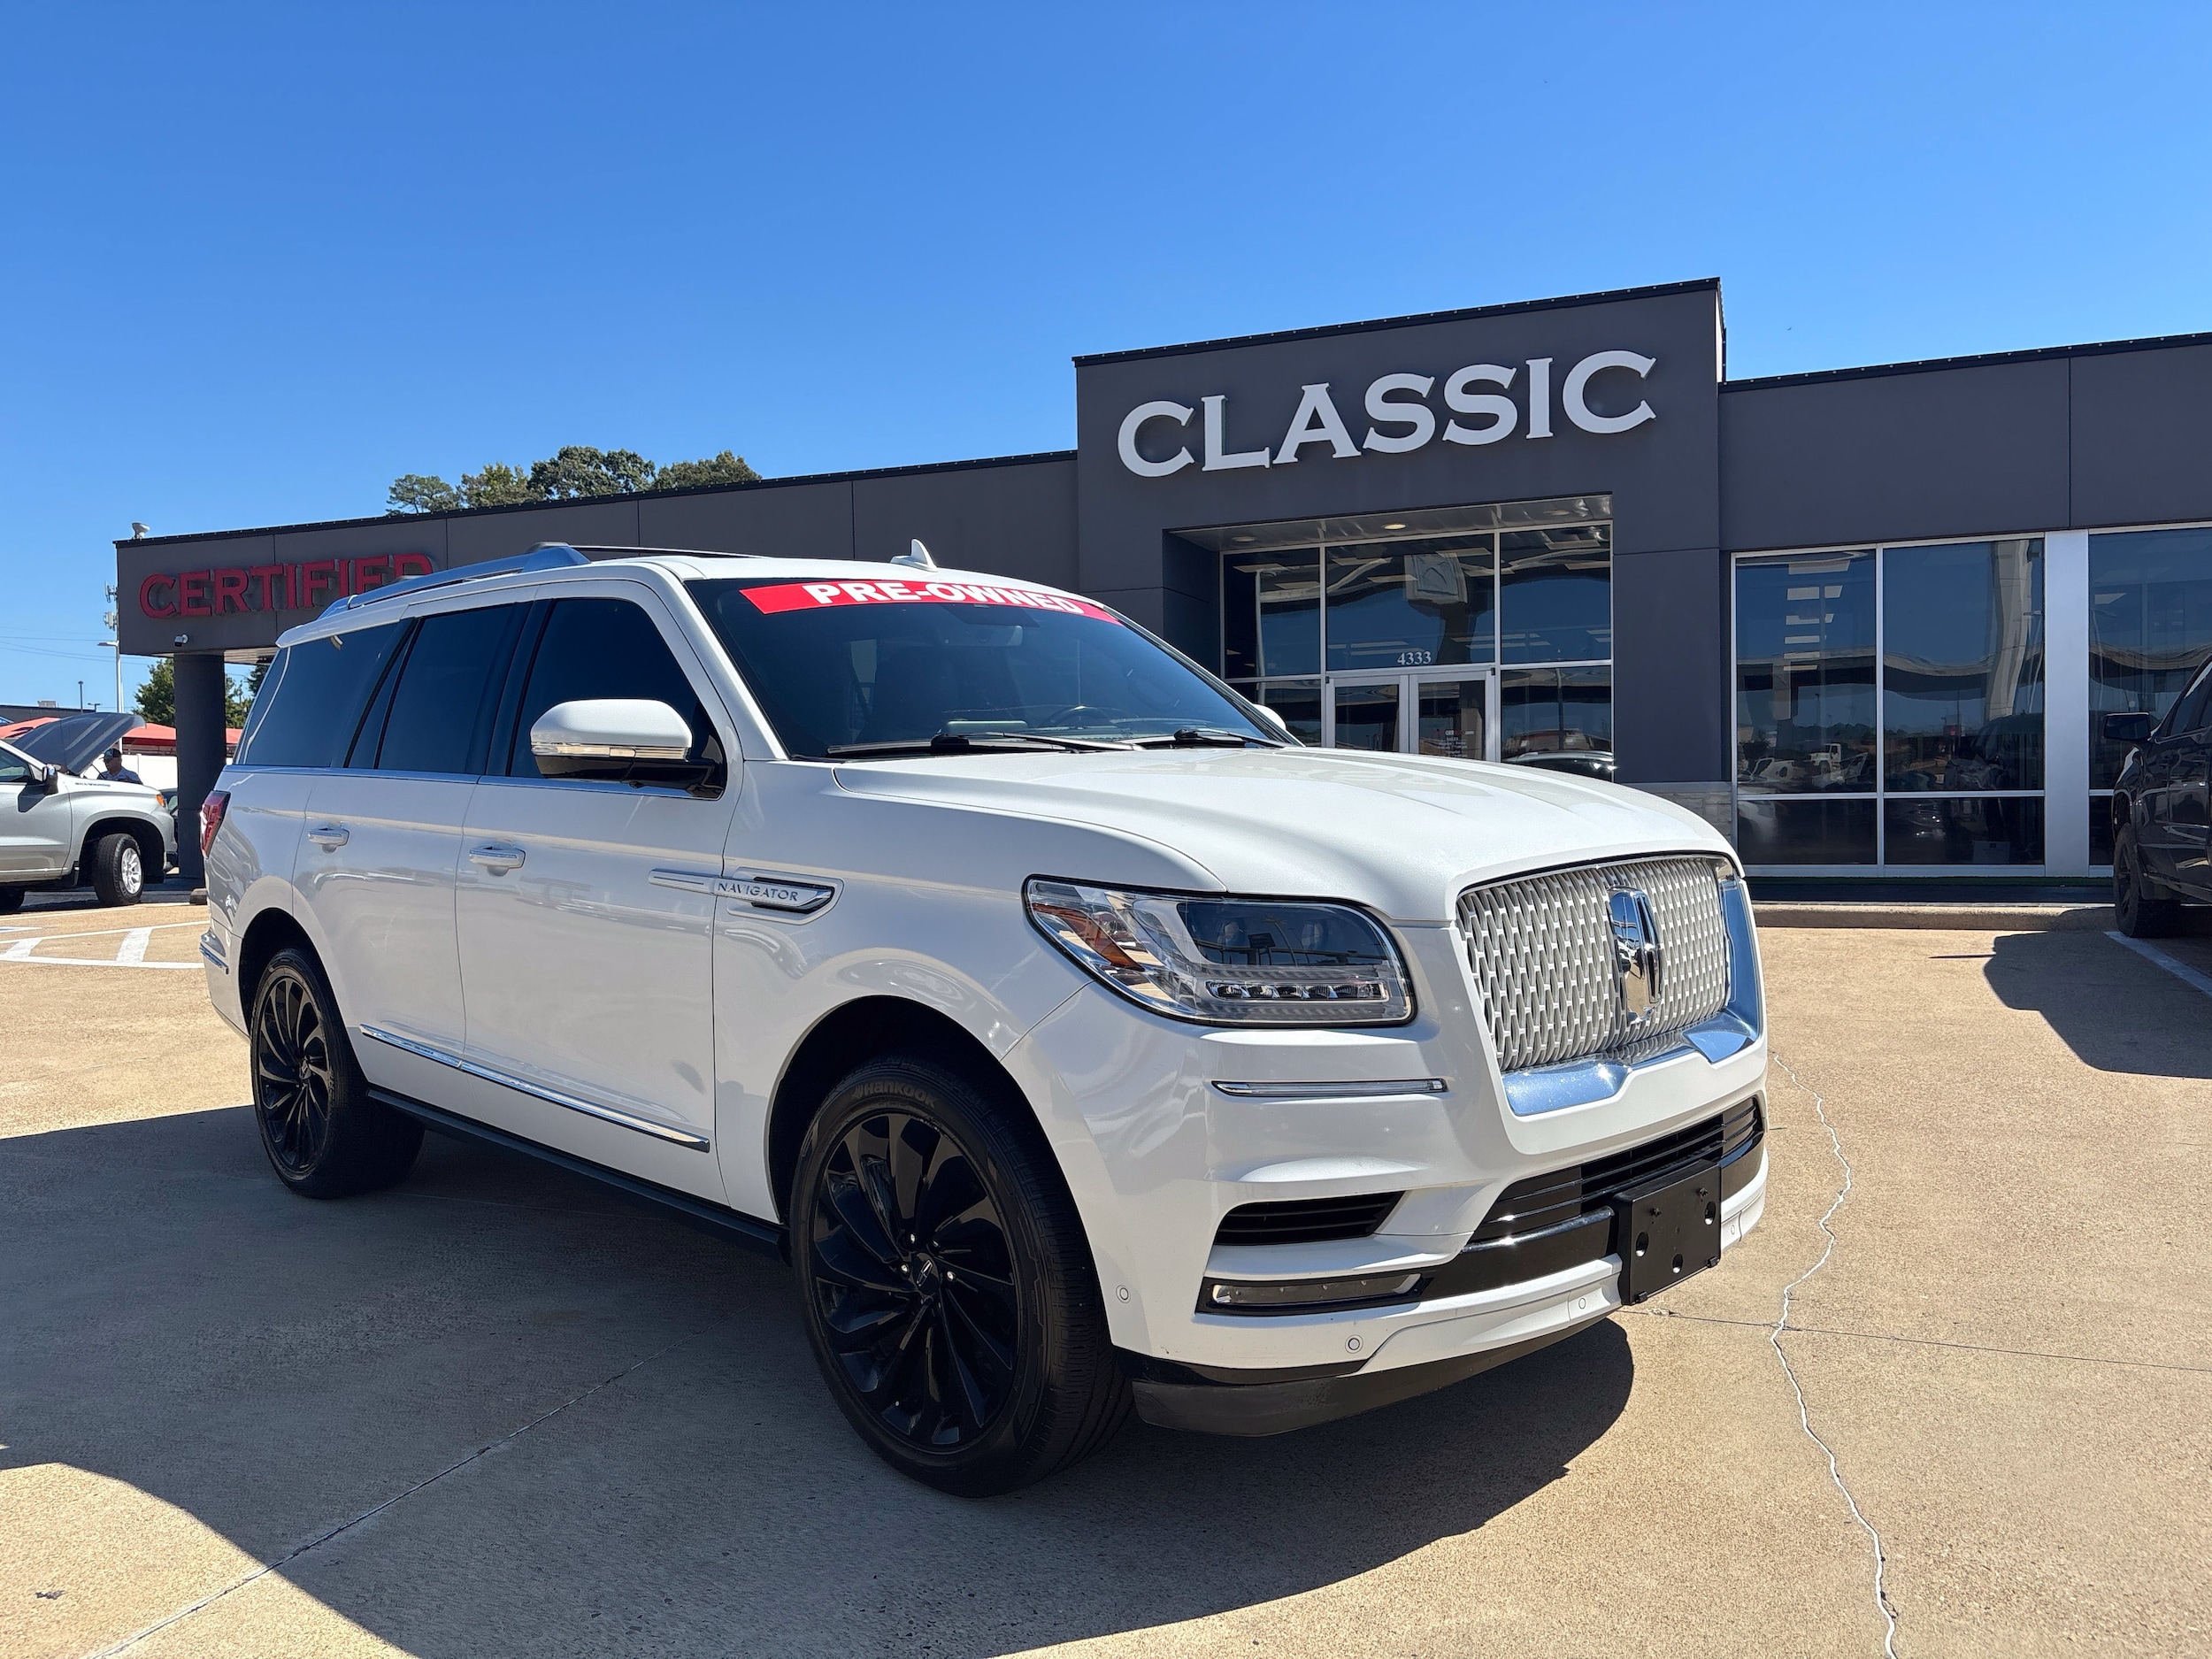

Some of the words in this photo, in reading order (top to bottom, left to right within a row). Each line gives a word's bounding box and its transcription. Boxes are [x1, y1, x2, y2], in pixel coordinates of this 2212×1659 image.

[1118, 349, 1657, 477] CLASSIC
[802, 582, 1085, 614] PRE-OWNED
[1397, 650, 1432, 665] 4333
[718, 882, 799, 902] NAVIGATOR
